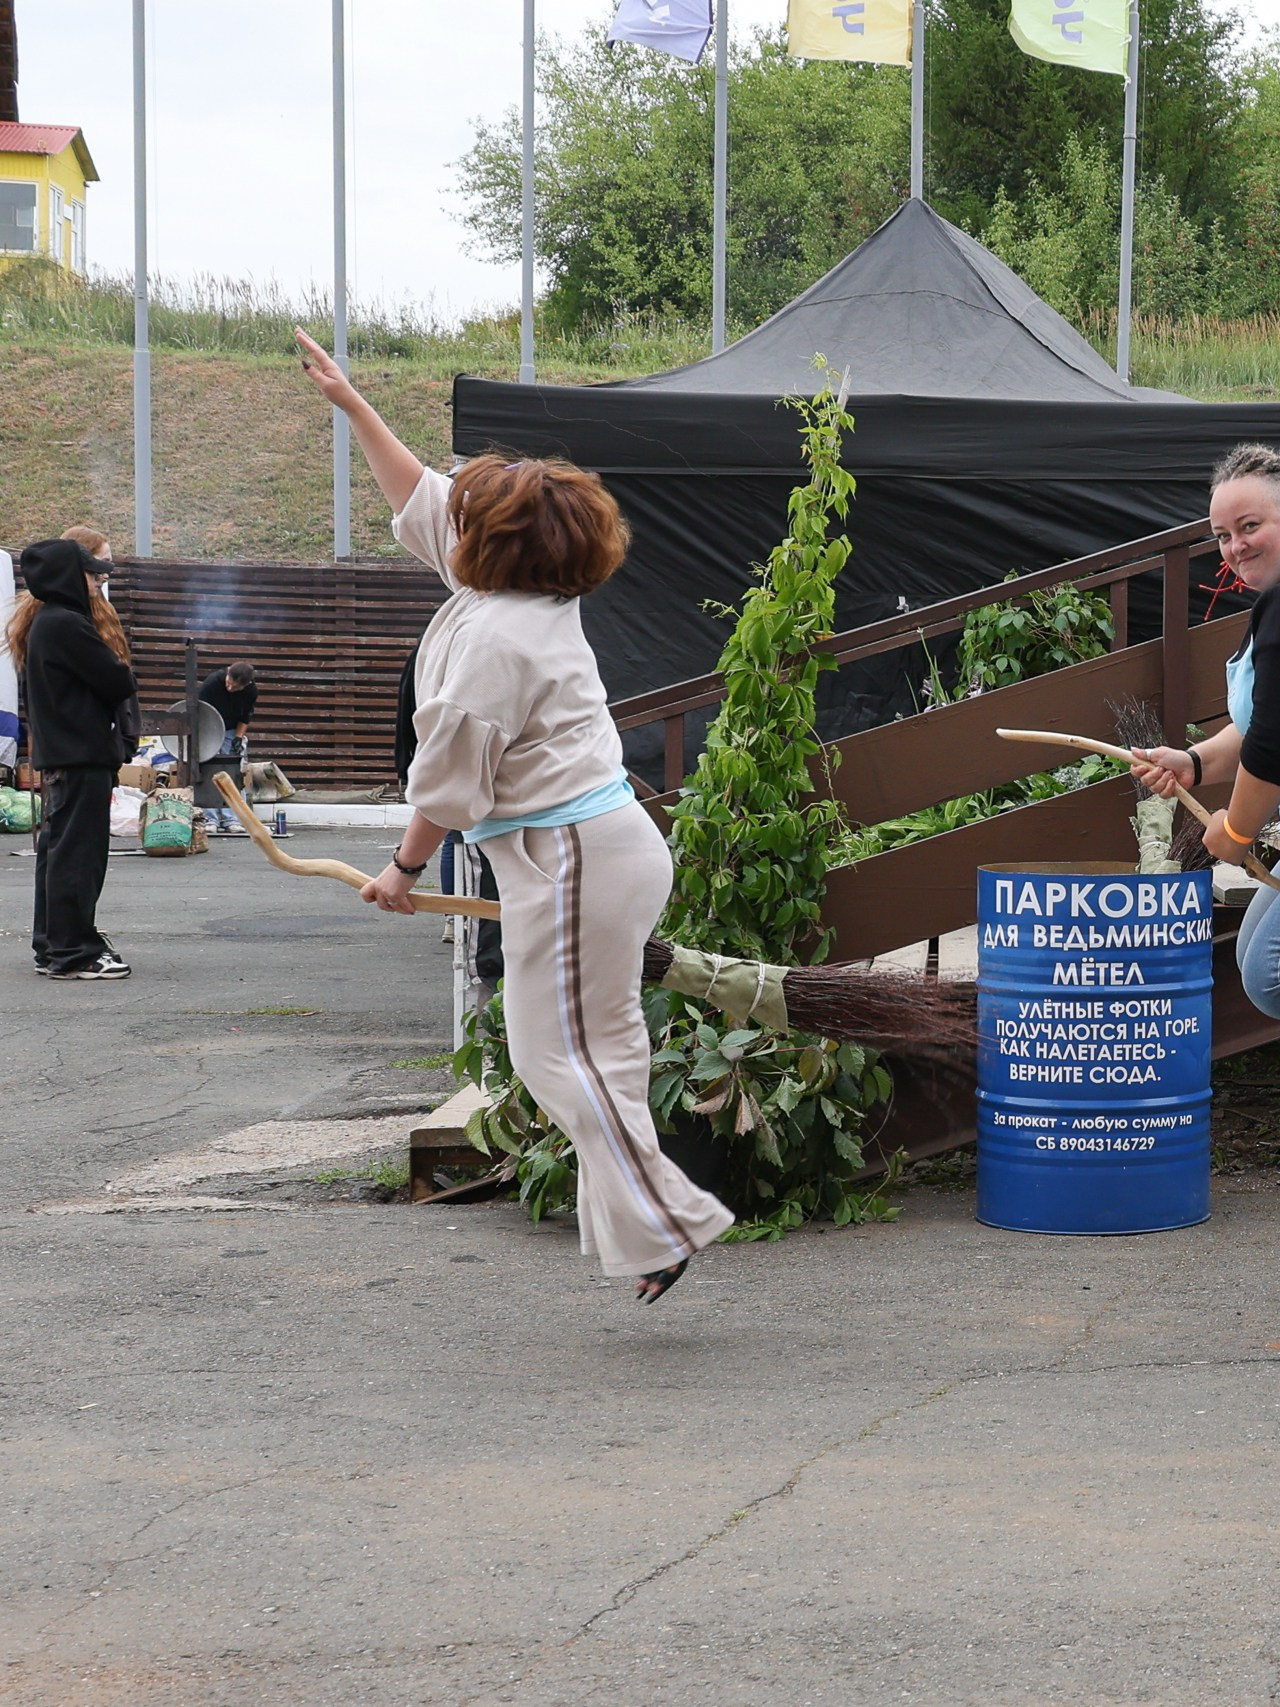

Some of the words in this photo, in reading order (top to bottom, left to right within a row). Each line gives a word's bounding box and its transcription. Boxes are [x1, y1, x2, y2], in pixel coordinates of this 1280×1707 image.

[995, 879, 1201, 918] ПАРКОВКА
[983, 923, 1019, 949] ДЛЯ
[1033, 916, 1212, 951] ВЕДЬМИНСКИХ
[1052, 957, 1145, 986] МЁТЕЛ
[1018, 998, 1104, 1020] УЛЁТНЫЕ
[1109, 998, 1172, 1018] ФОТКИ
[996, 1019, 1127, 1041] ПОЛУЧАЮТСЯ
[1133, 1022, 1160, 1039] НА
[1164, 1016, 1200, 1037] ГОРЕ.
[1000, 1037, 1031, 1058] КАК
[1035, 1042, 1166, 1061] НАЛЕТАЕТЕСЬ
[1009, 1063, 1083, 1084] ВЕРНИТЕ
[1089, 1065, 1161, 1085] СЮДА.
[993, 1111, 1006, 1126] За
[1008, 1115, 1057, 1129] прокат
[1071, 1115, 1128, 1132] любую
[1132, 1115, 1177, 1131] сумму
[1179, 1114, 1193, 1126] на
[1035, 1136, 1056, 1150] СБ
[1059, 1136, 1156, 1152] 89043146729
